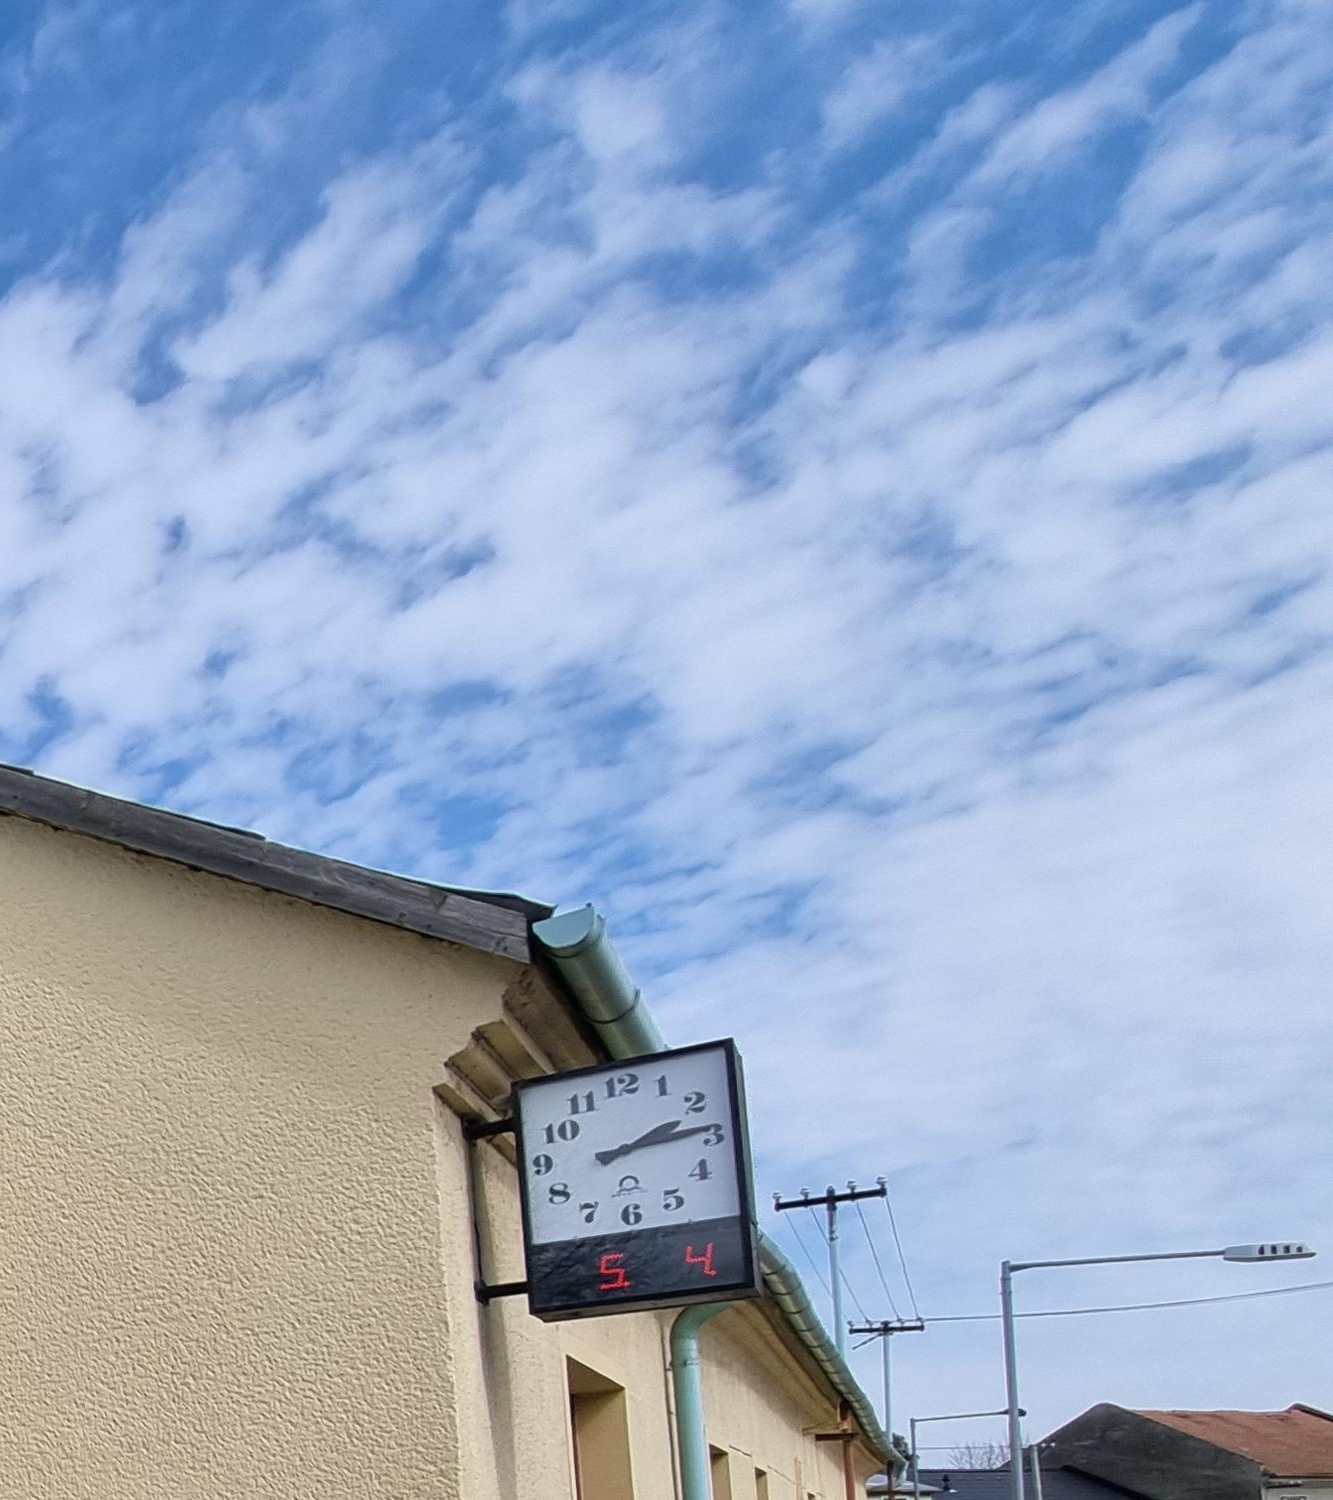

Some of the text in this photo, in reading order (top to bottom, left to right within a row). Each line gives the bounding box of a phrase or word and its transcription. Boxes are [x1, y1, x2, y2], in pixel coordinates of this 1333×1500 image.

[604, 1073, 639, 1099] 12
[654, 1074, 671, 1097] 1
[567, 1091, 597, 1115] 11
[684, 1091, 706, 1114] 2
[543, 1119, 580, 1144] 10
[702, 1123, 725, 1147] 3
[533, 1154, 554, 1176] 9
[689, 1158, 712, 1181] 4
[549, 1183, 571, 1204] 8
[663, 1188, 684, 1211] 5
[580, 1201, 598, 1223] 7
[620, 1203, 643, 1226] 6
[599, 1242, 718, 1291] 5 4
